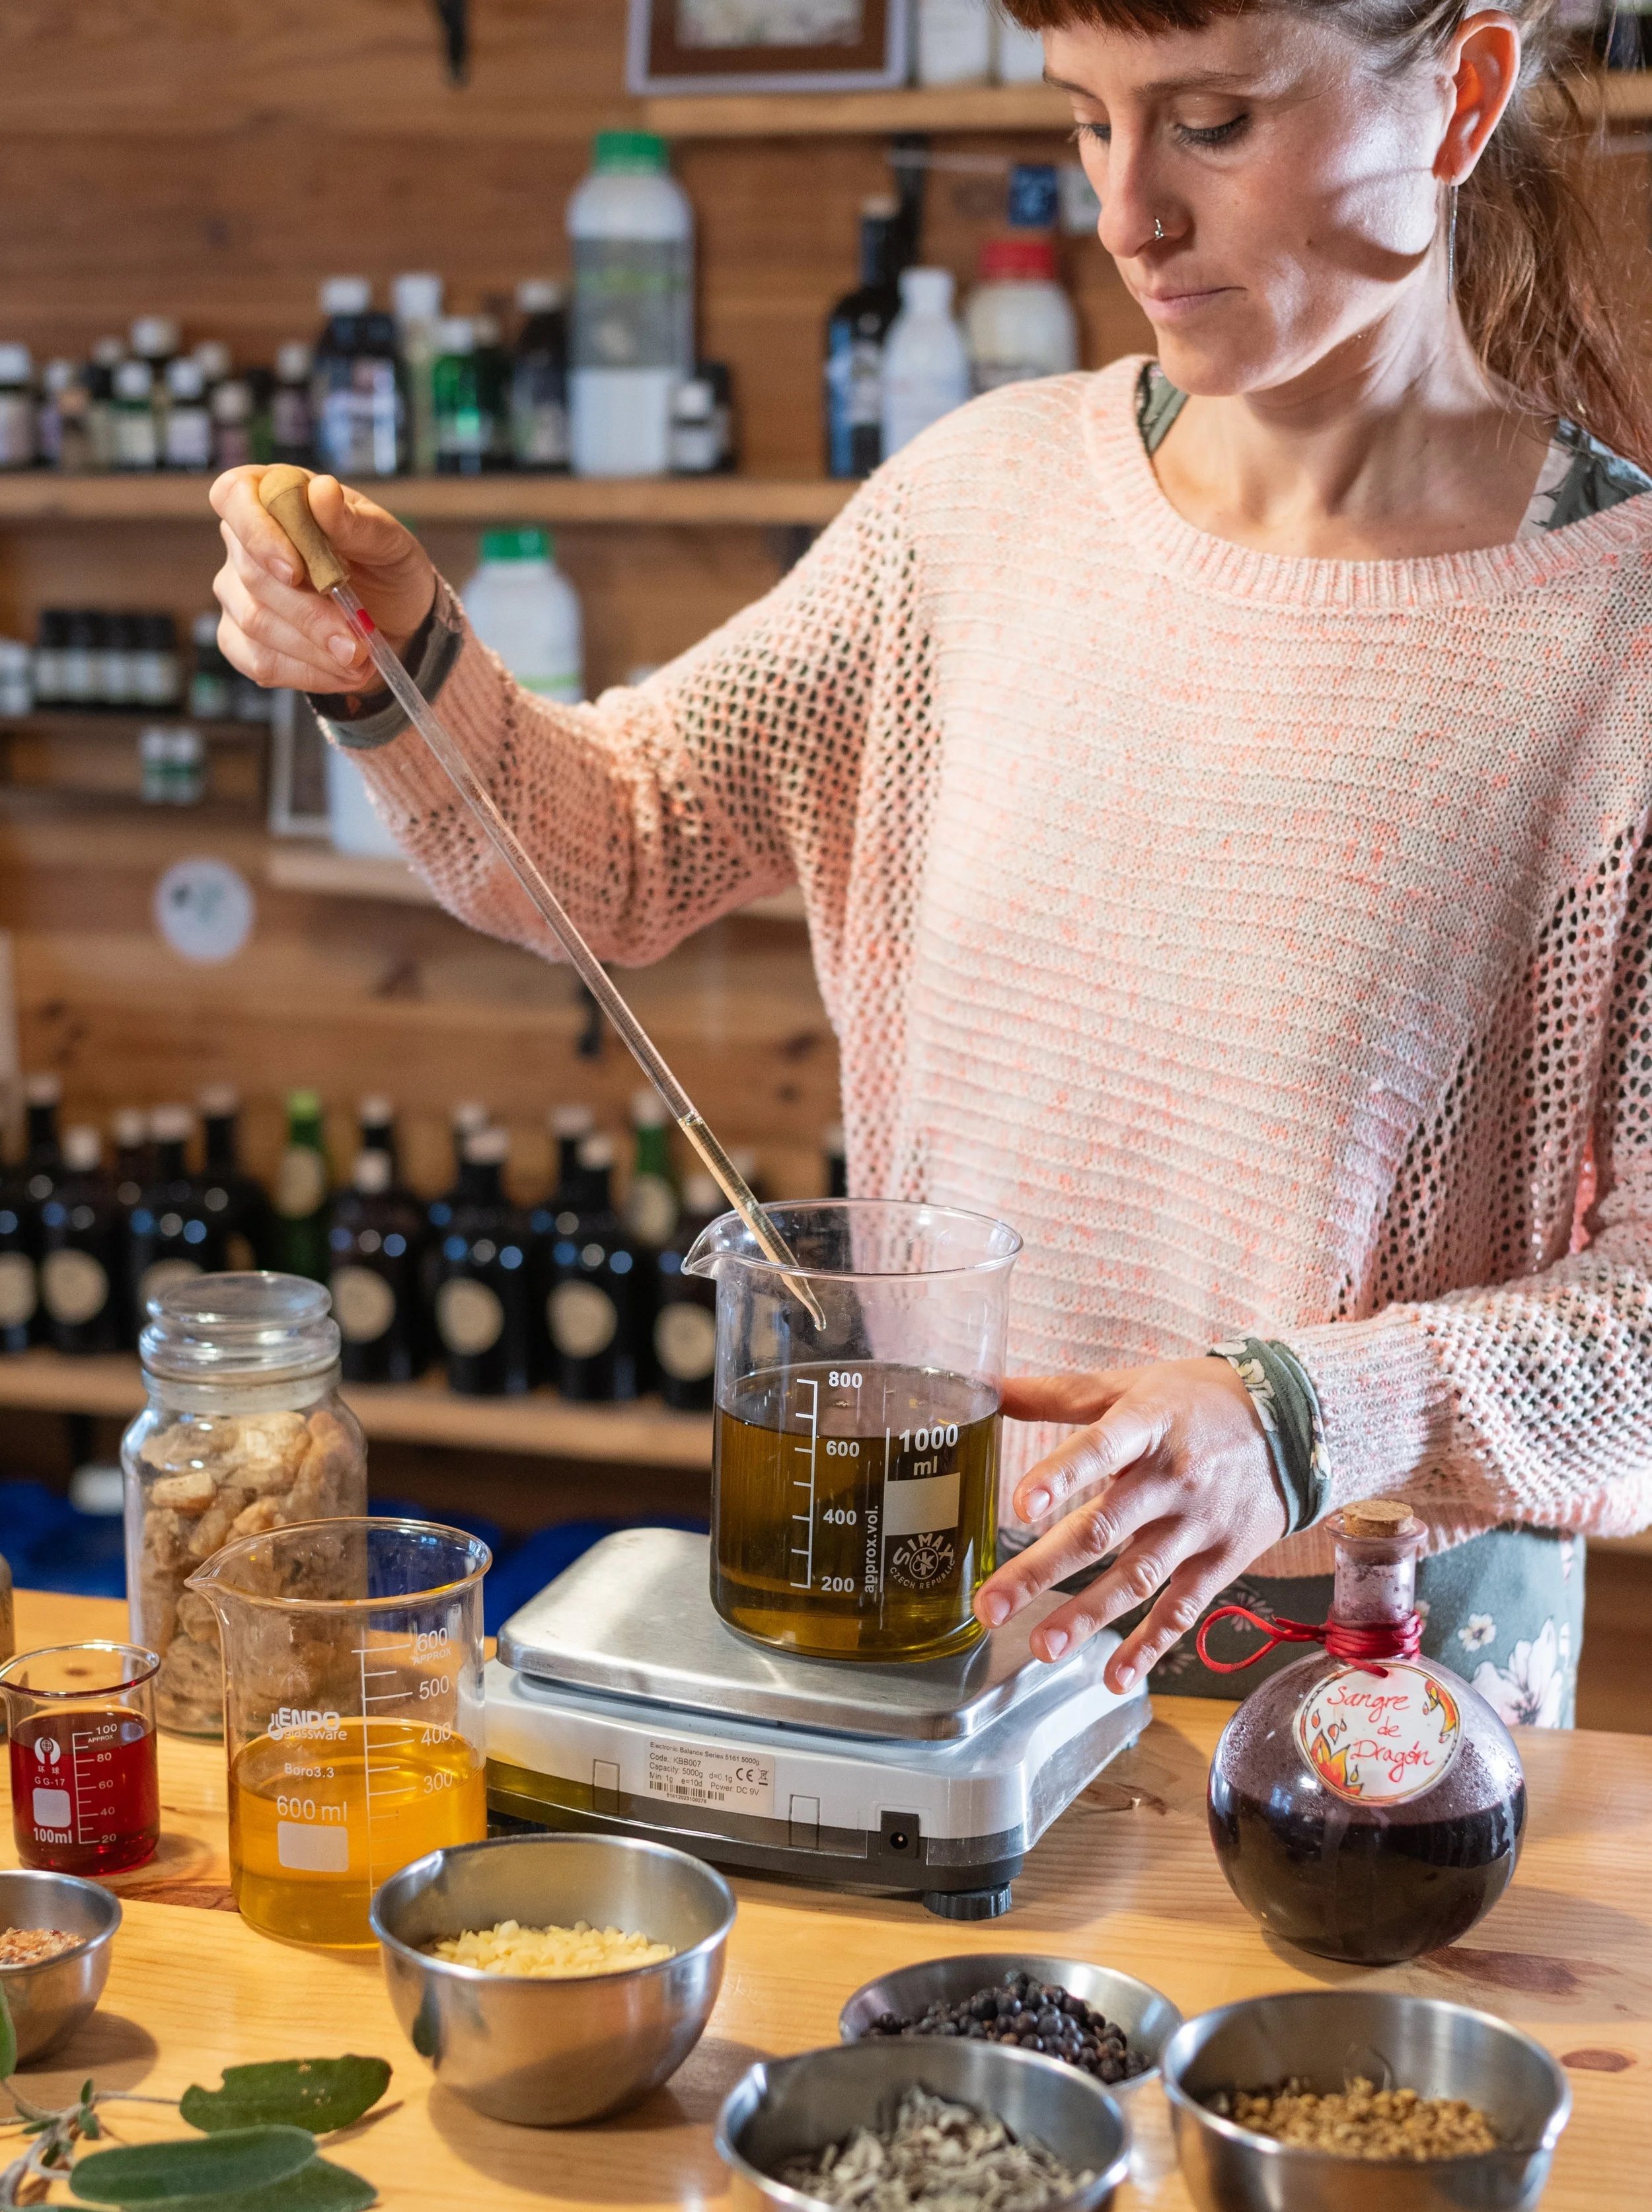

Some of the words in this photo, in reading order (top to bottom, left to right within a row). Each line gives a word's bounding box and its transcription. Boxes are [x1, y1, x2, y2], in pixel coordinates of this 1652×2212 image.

[829, 1371, 862, 1388] 800
[899, 1424, 958, 1452] 1000
[826, 1440, 860, 1457] 600
[913, 1455, 938, 1476] ml
[823, 1509, 856, 1525] 400
[864, 1506, 878, 1593] approx.vol.
[893, 1533, 954, 1565] SIMAX
[821, 1576, 854, 1593] 200
[890, 1567, 916, 1589] CZECH
[919, 1560, 956, 1589] REPUBLIC
[418, 1627, 448, 1652] 600
[420, 1675, 449, 1700] 500
[1326, 1686, 1410, 1723] Sangre
[278, 1707, 340, 1731] ENDO
[1377, 1716, 1402, 1737] de
[88, 1734, 114, 1743] APPROX
[96, 1724, 118, 1735] 100
[284, 1729, 348, 1741] glassware
[421, 1722, 451, 1745] 400
[96, 1752, 112, 1763] 80
[650, 1741, 679, 1752] Electronic
[680, 1747, 703, 1756] Balance
[705, 1751, 724, 1759] Series
[741, 1756, 760, 1766] 5000g
[673, 1757, 701, 1767] KBB007
[1350, 1739, 1435, 1782] Dragón
[285, 1763, 334, 1778] Boro3.3
[683, 1767, 703, 1778] 5000g
[98, 1780, 113, 1790] 60
[424, 1769, 453, 1794] 300
[666, 1774, 673, 1784] 1g
[681, 1778, 702, 1787] e=10d
[736, 1786, 747, 1794] DC
[100, 1806, 115, 1816] 40
[277, 1795, 315, 1819] 600
[321, 1801, 348, 1822] ml
[34, 1827, 72, 1844] 100ml
[102, 1833, 116, 1843] 20
